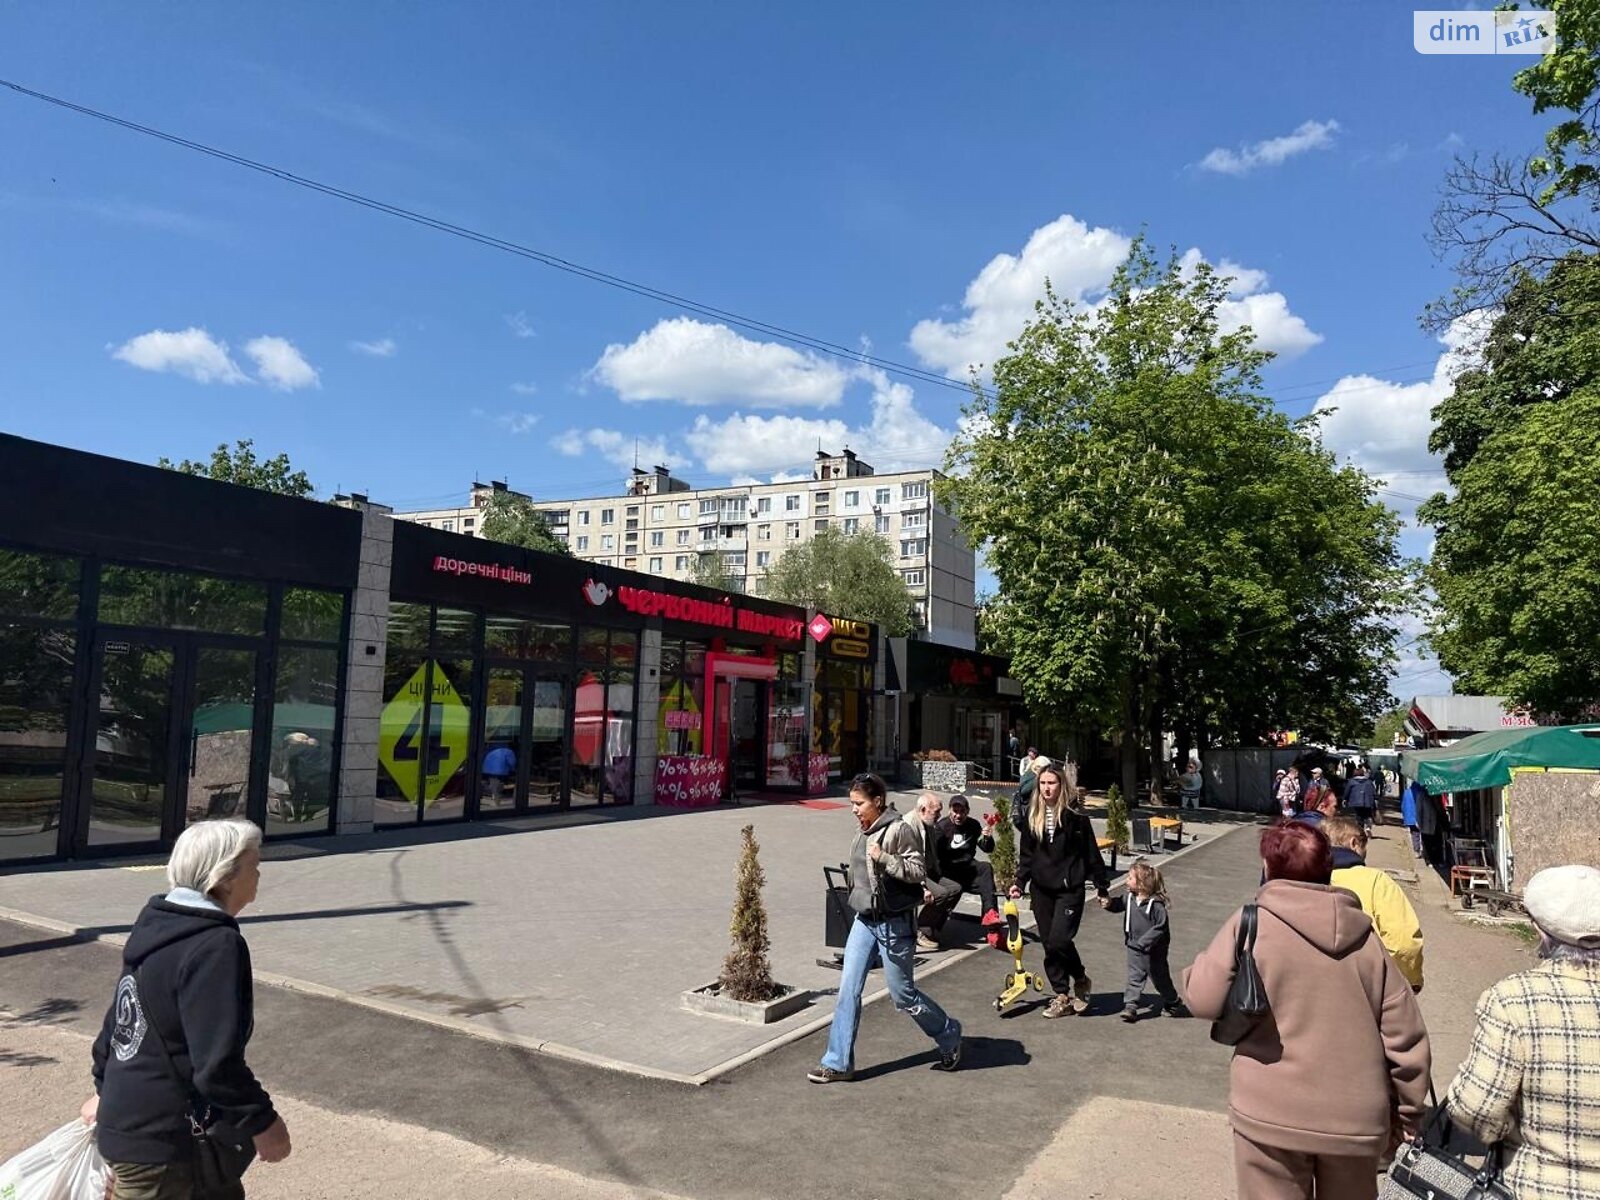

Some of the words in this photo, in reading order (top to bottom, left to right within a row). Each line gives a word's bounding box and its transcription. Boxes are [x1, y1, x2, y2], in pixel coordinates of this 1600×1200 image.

[433, 556, 499, 577] доречні
[501, 566, 531, 584] ціни
[618, 585, 734, 628] ЧЕРВОНИЙ
[409, 682, 451, 696] ЦІНИ
[393, 702, 450, 775] 4
